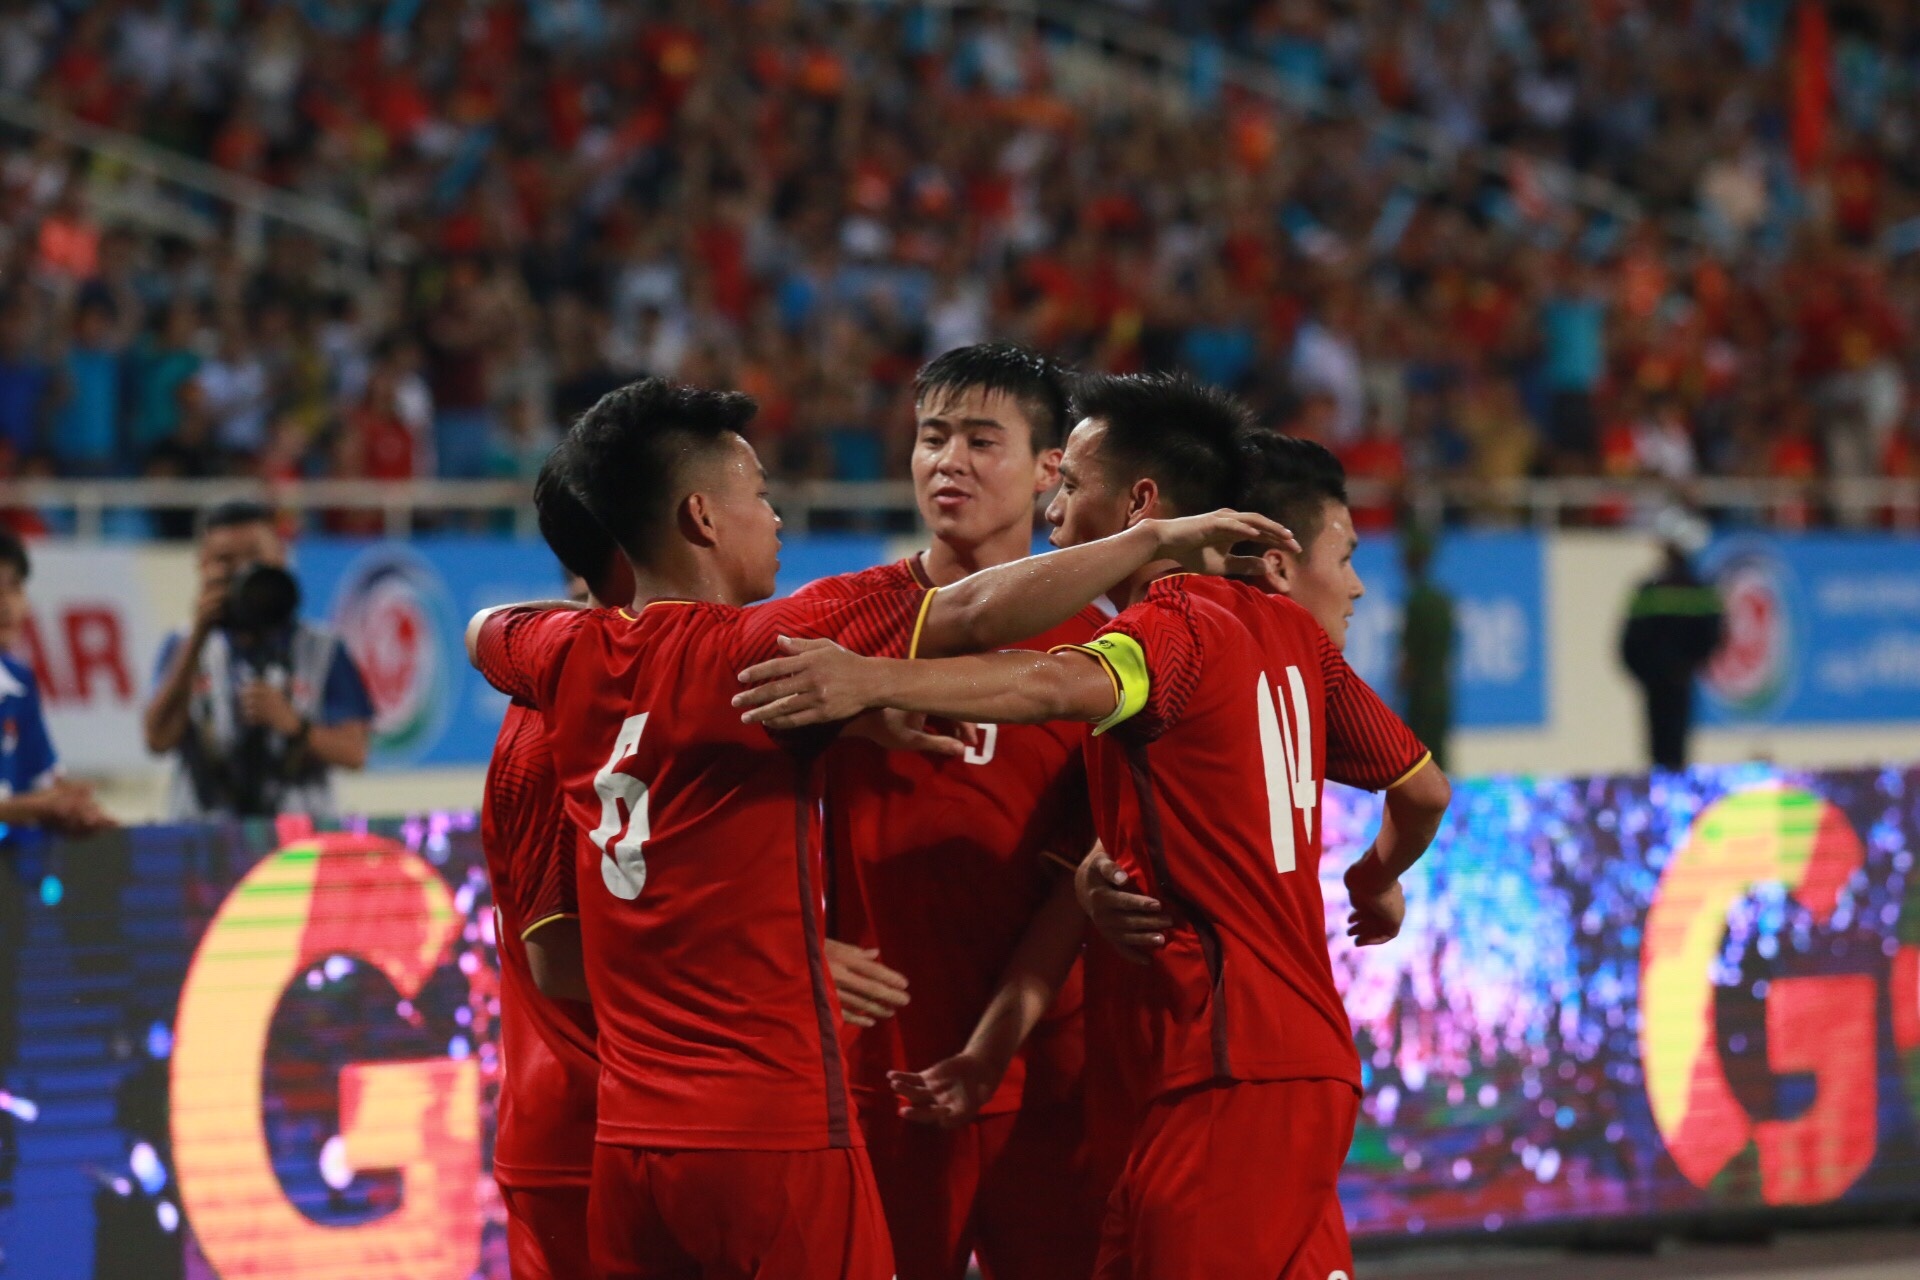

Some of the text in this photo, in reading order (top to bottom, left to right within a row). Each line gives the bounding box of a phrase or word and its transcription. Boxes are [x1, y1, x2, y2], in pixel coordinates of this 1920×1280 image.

[588, 711, 651, 901] 6
[1256, 665, 1317, 874] 14
[168, 831, 483, 1280] G
